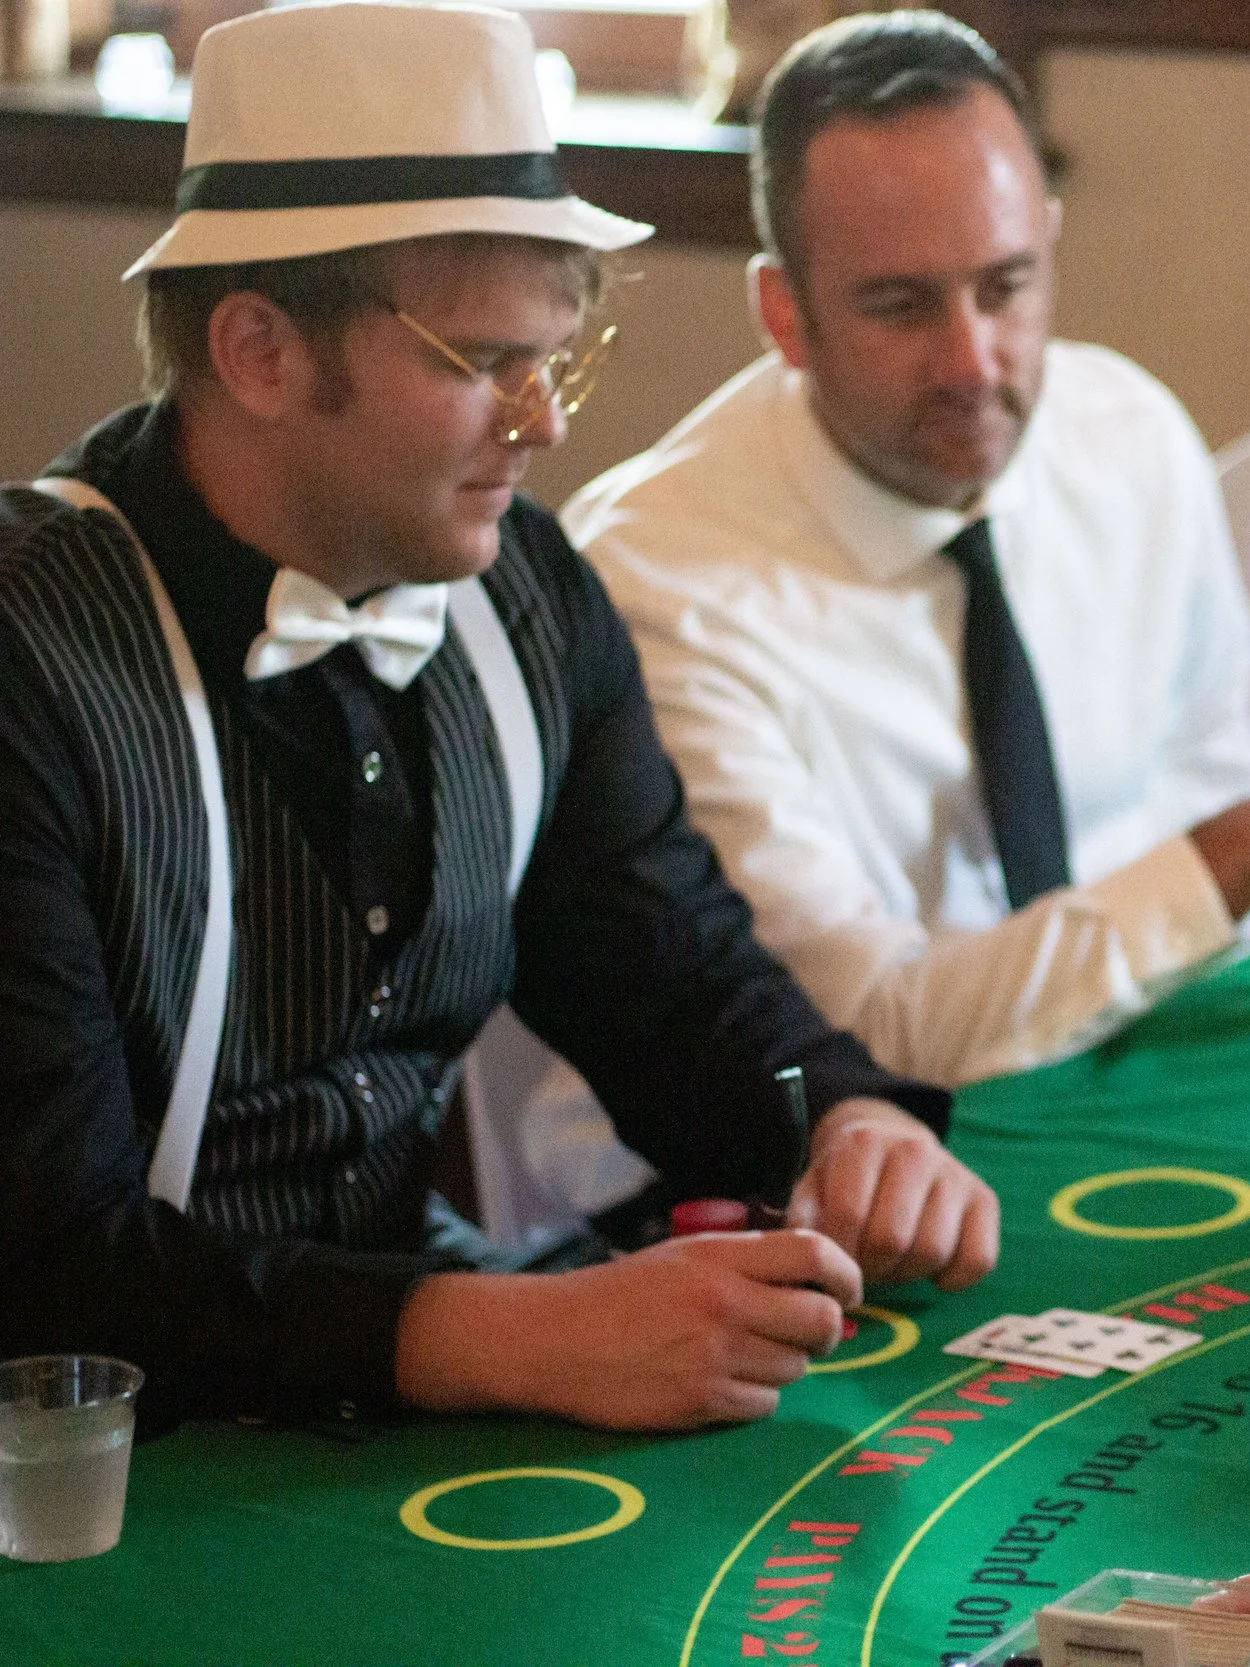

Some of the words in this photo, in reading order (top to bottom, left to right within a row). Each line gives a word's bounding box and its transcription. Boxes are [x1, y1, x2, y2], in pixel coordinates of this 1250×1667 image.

[1150, 1398, 1248, 1437] 16
[1061, 1432, 1165, 1496] and
[972, 1496, 1087, 1590] stand
[946, 1595, 1013, 1640] on
